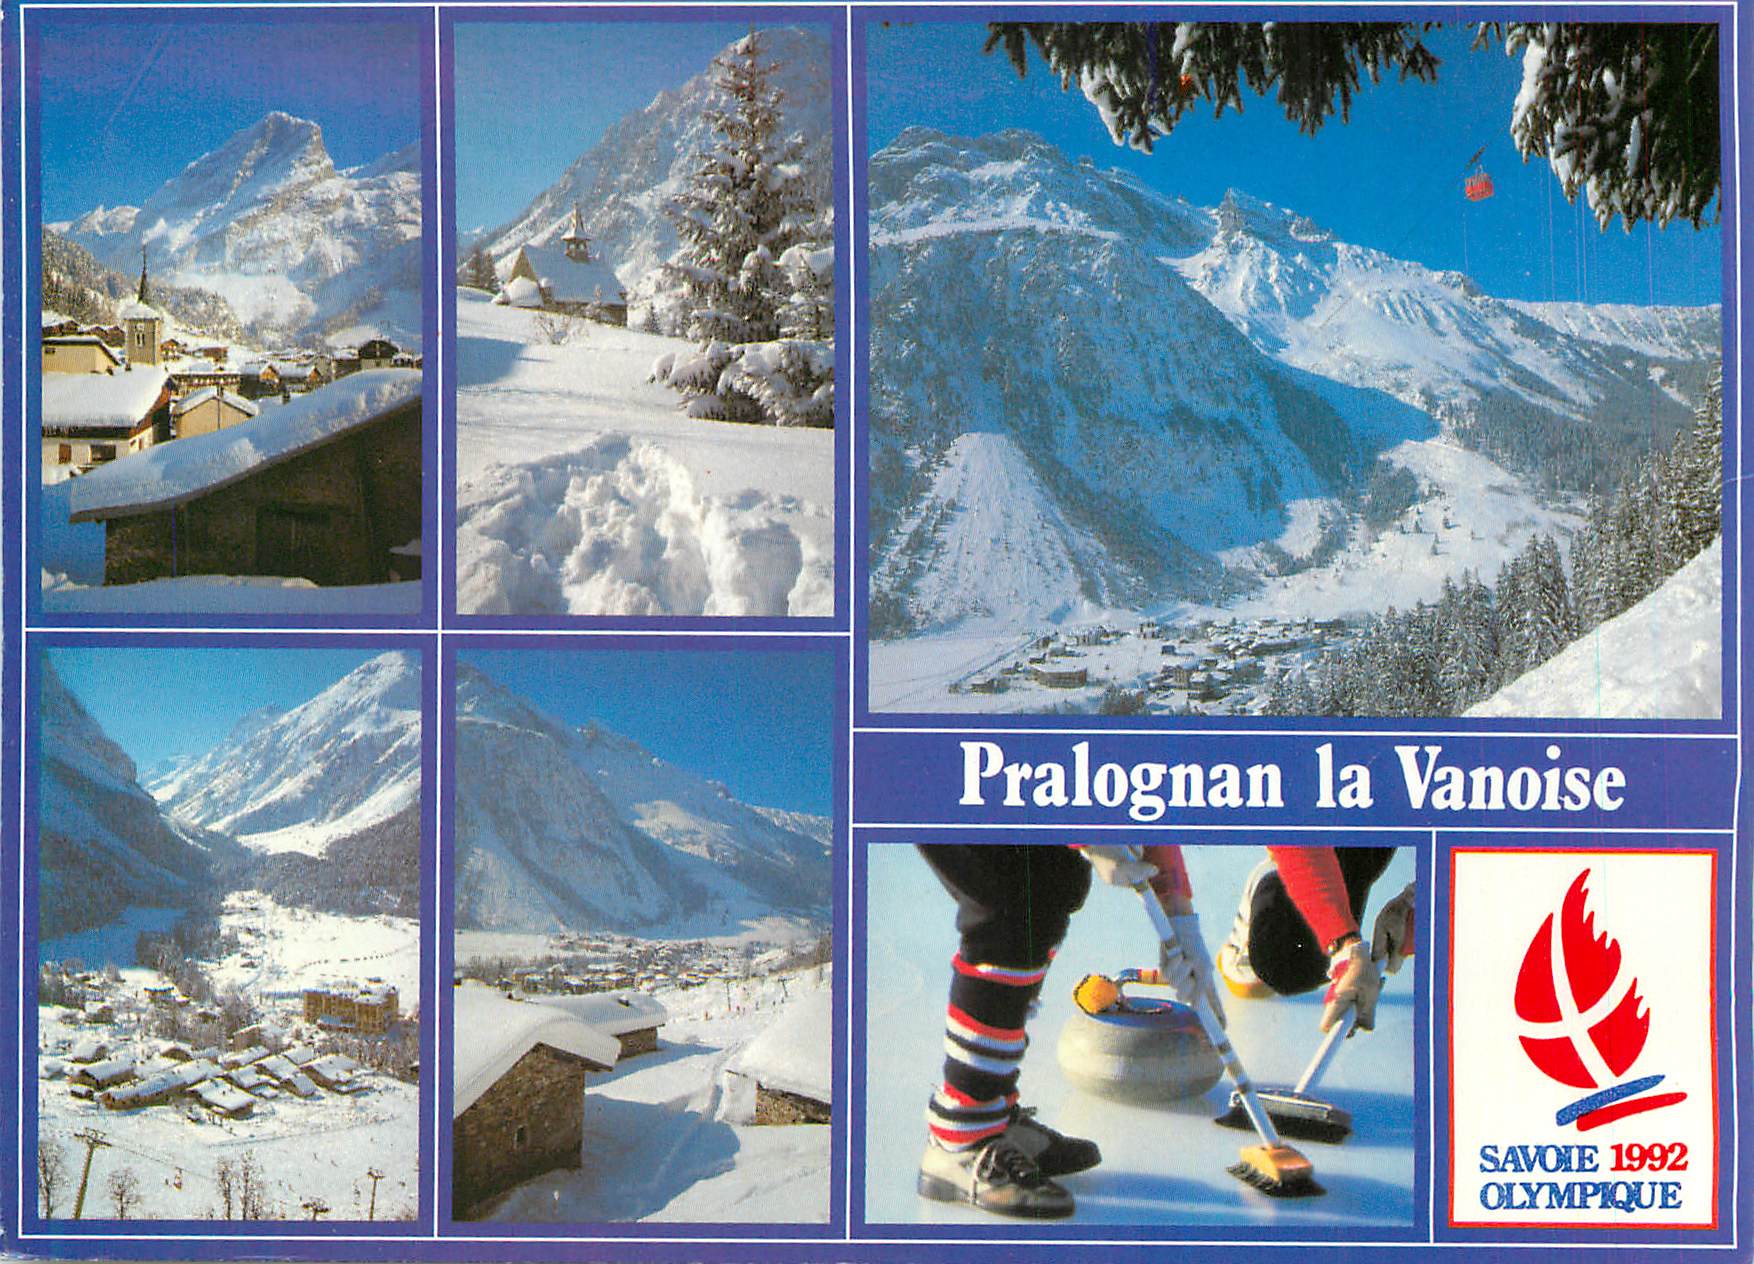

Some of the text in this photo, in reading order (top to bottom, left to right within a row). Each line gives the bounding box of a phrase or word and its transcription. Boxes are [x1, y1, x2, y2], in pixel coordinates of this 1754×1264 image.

[959, 741, 1626, 821] Pralognan la Vanoise
[1480, 1142, 1689, 1173] SAVOIE 1992
[1480, 1181, 1683, 1213] OLYMPIQUE
